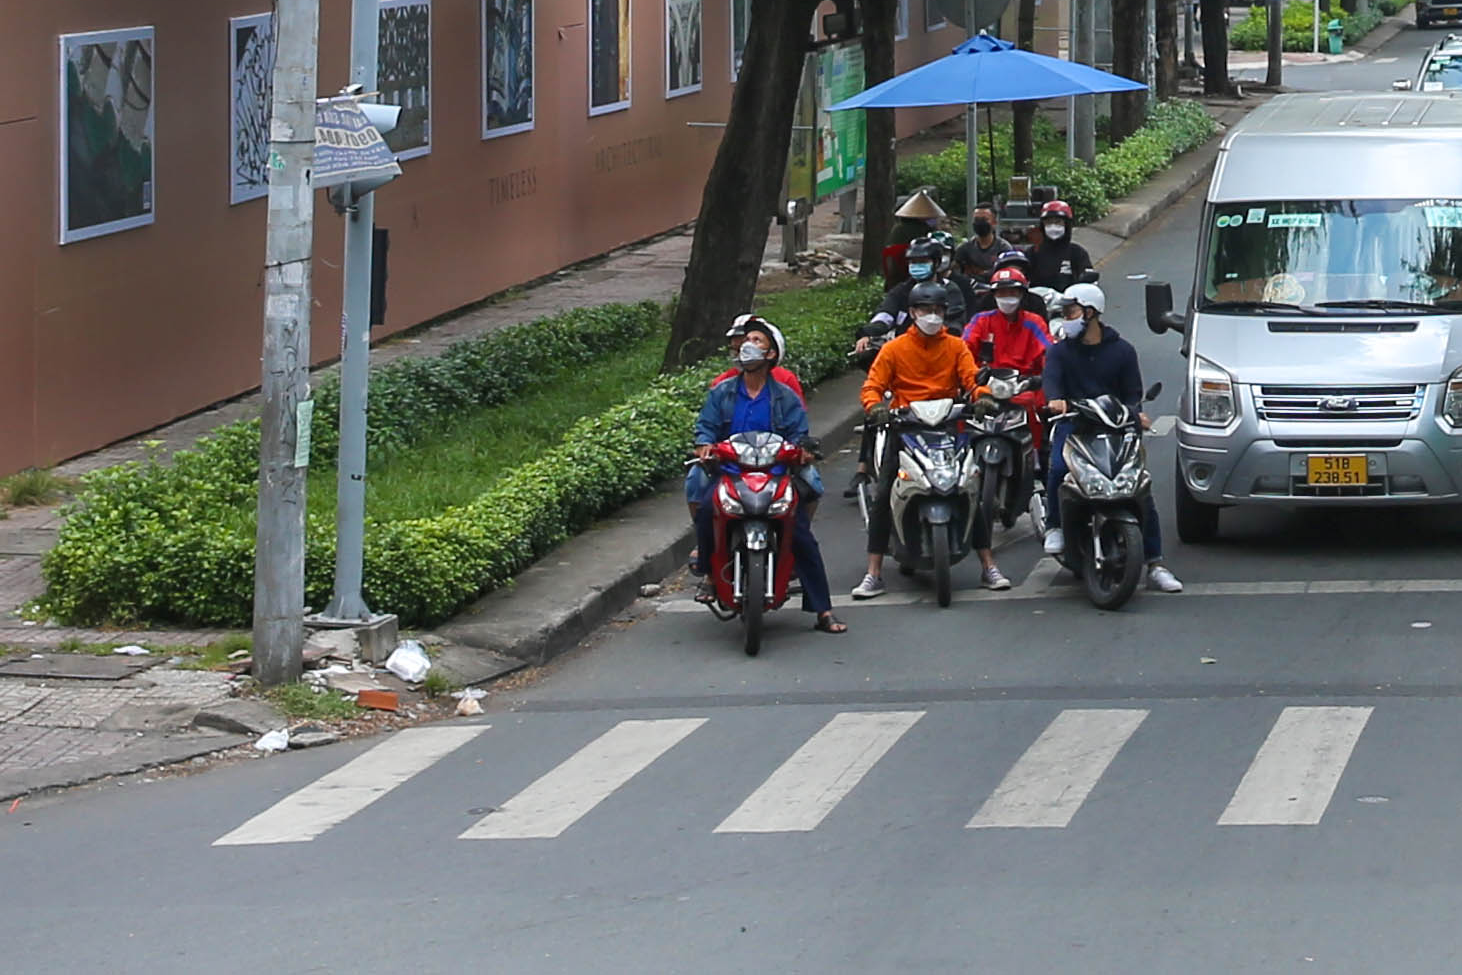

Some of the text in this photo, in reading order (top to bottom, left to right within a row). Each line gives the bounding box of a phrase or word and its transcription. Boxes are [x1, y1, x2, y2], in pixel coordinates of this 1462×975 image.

[488, 167, 537, 208] TIMELESS
[1323, 457, 1350, 470] 51B
[1314, 471, 1360, 484] 238.51
